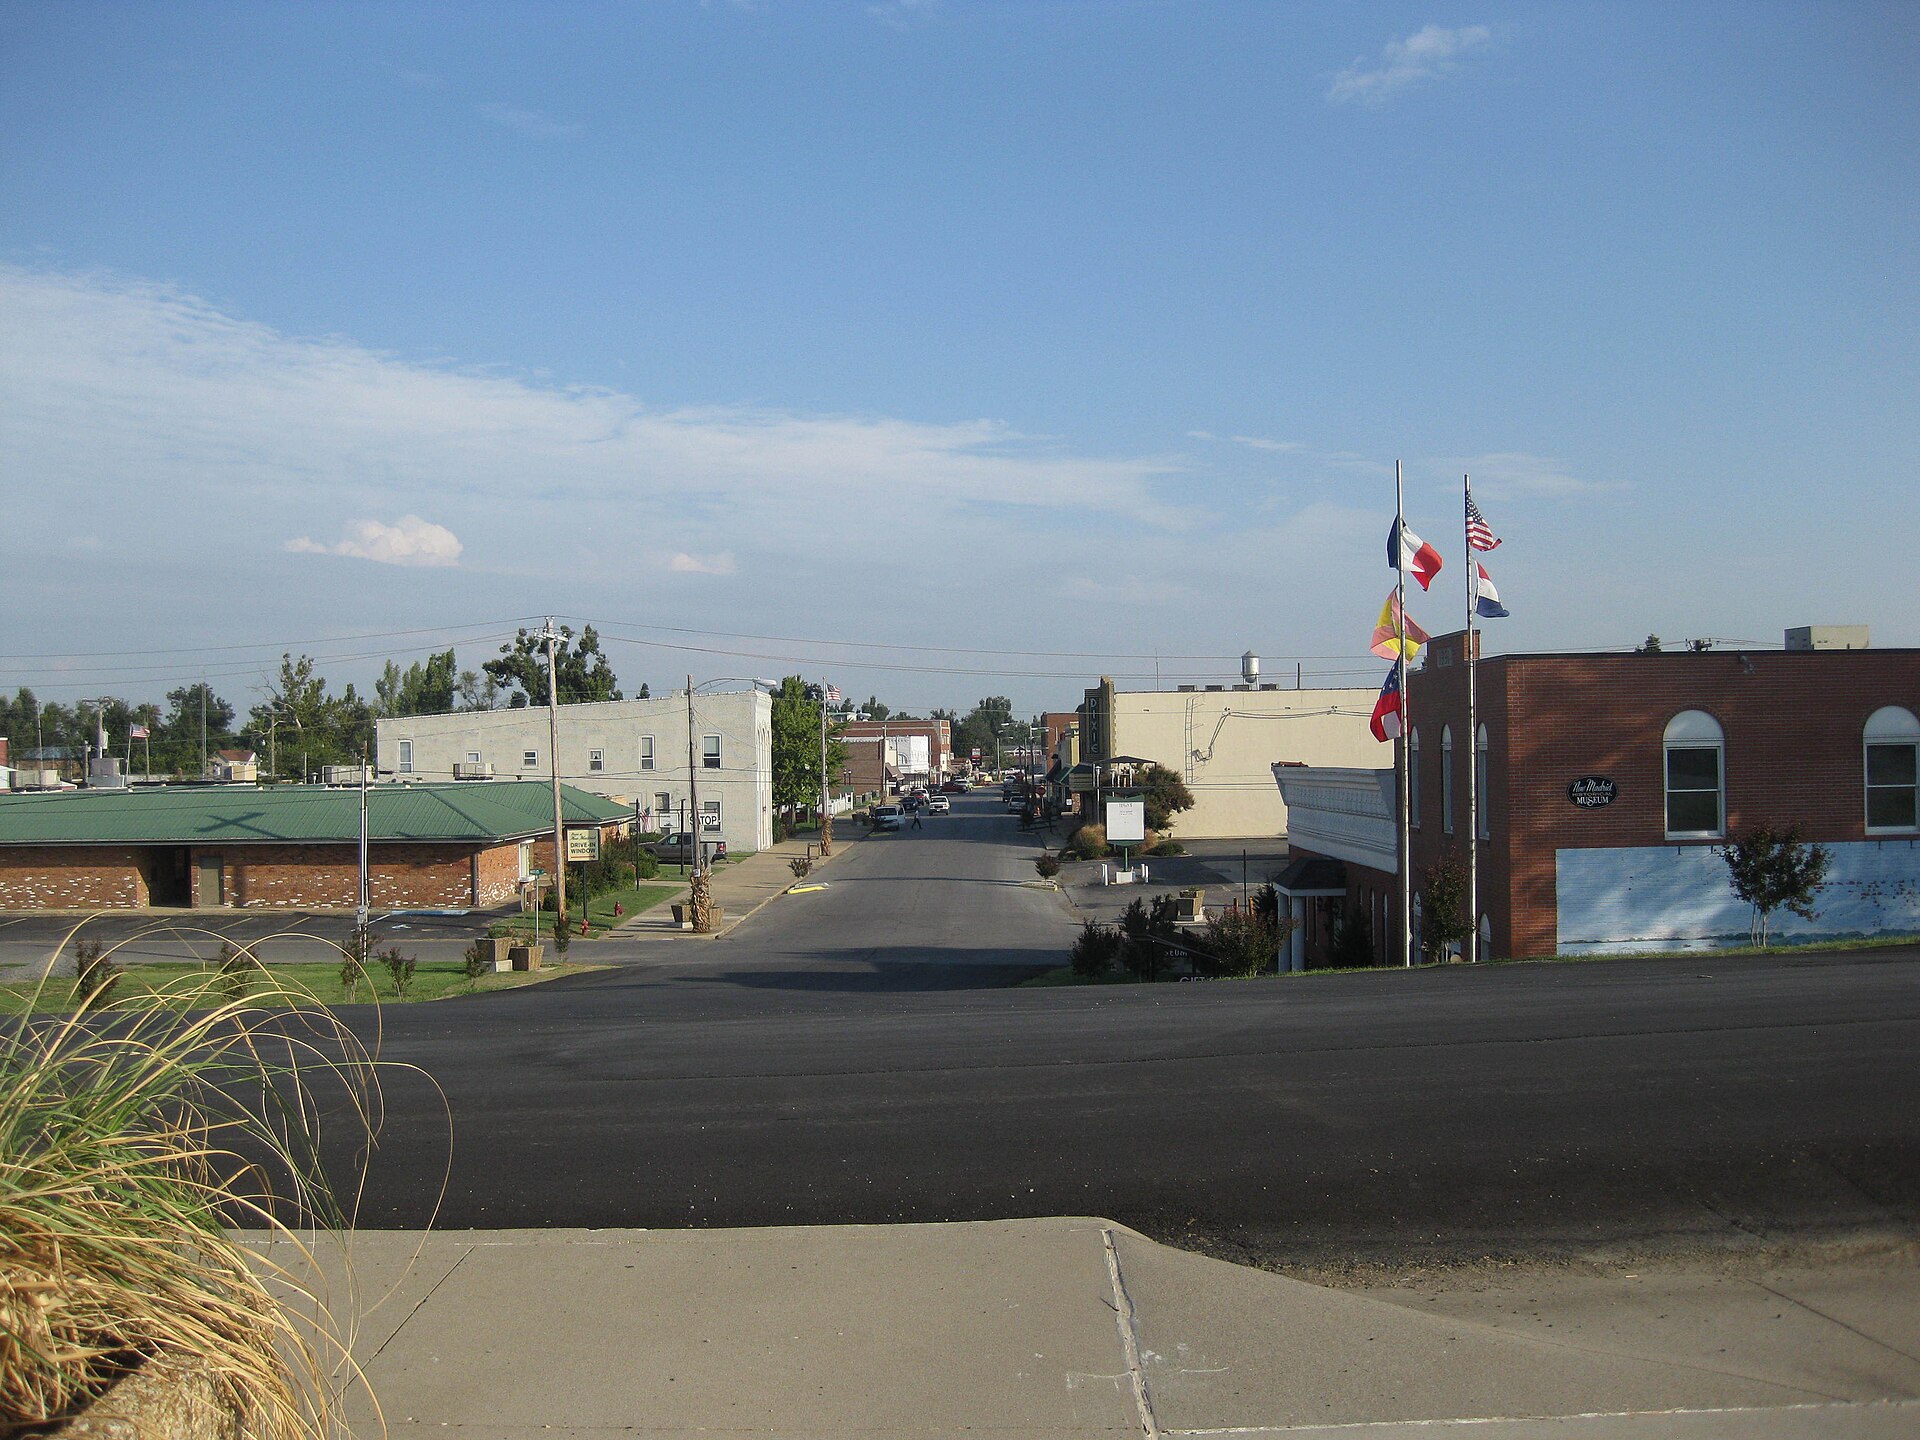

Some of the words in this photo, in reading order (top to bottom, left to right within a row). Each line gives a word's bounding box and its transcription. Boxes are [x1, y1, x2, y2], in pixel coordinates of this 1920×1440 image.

[1090, 697, 1099, 753] DIXIE
[1572, 780, 1588, 793] New
[1586, 778, 1613, 792] Madrid
[1576, 796, 1609, 806] MUSEUM
